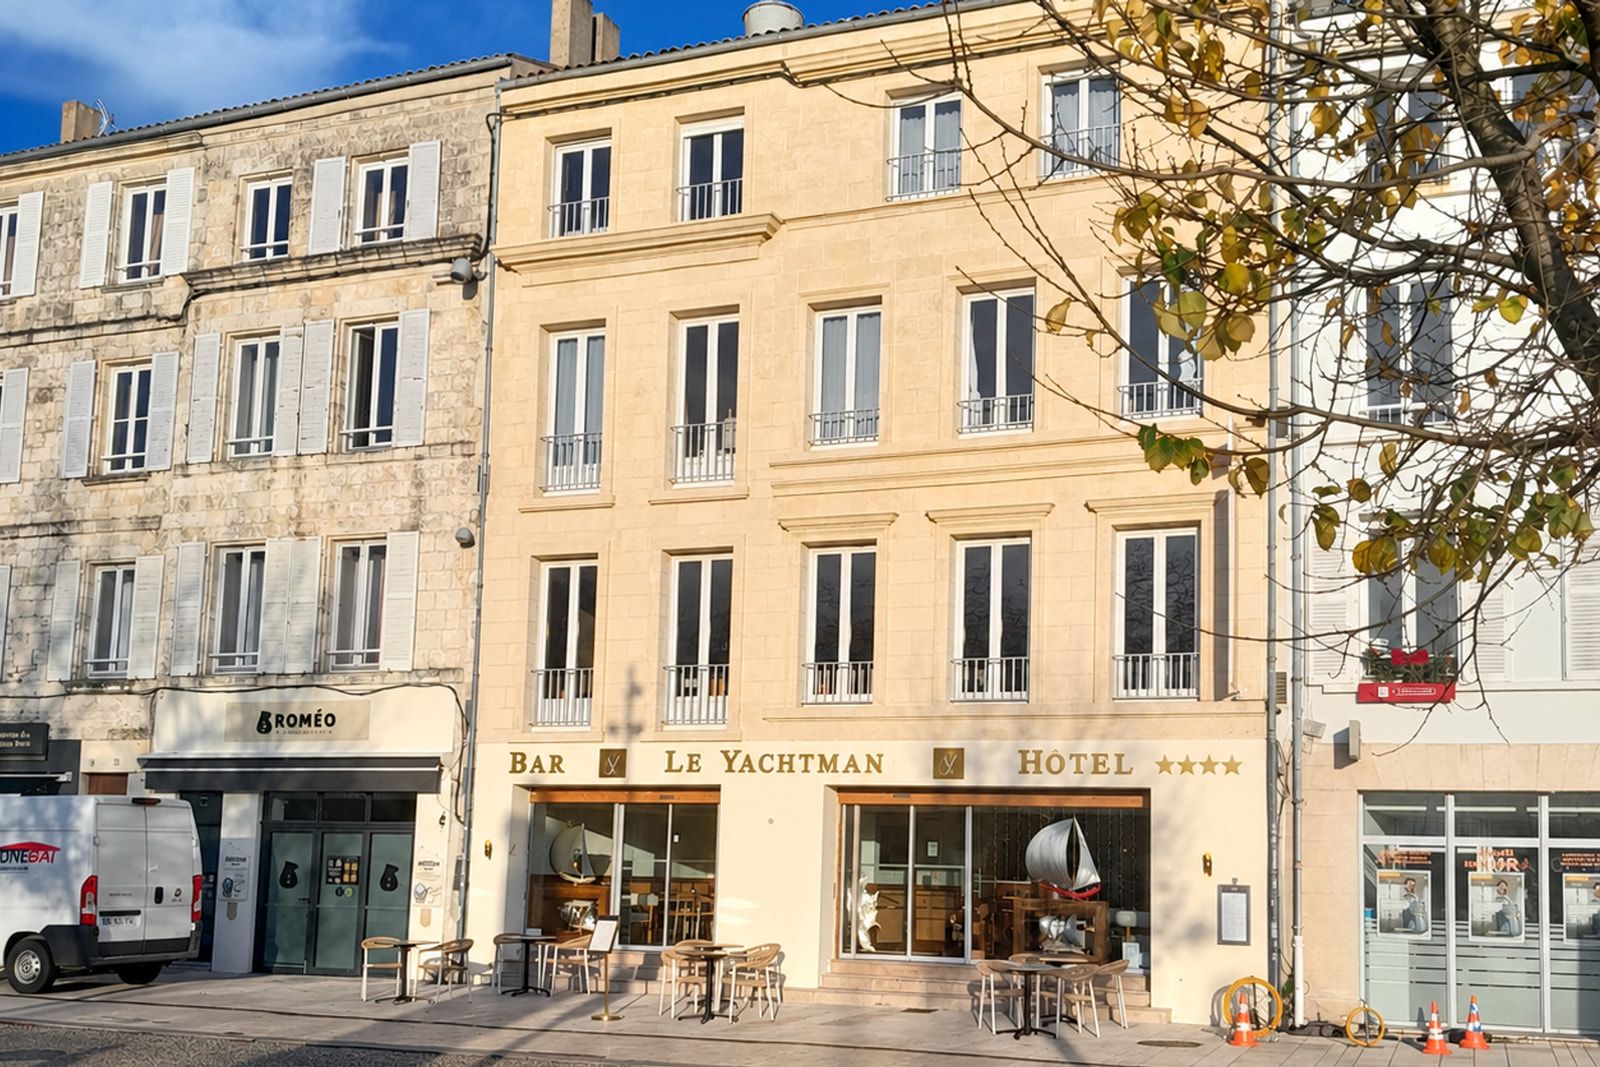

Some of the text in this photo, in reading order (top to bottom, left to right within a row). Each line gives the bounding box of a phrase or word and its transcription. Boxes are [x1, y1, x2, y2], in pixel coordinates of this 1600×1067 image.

[275, 708, 336, 728] ROMÉO
[509, 751, 565, 774] BAR
[664, 750, 884, 774] LE YACHTMAN
[1018, 749, 1134, 775] HÔTEL
